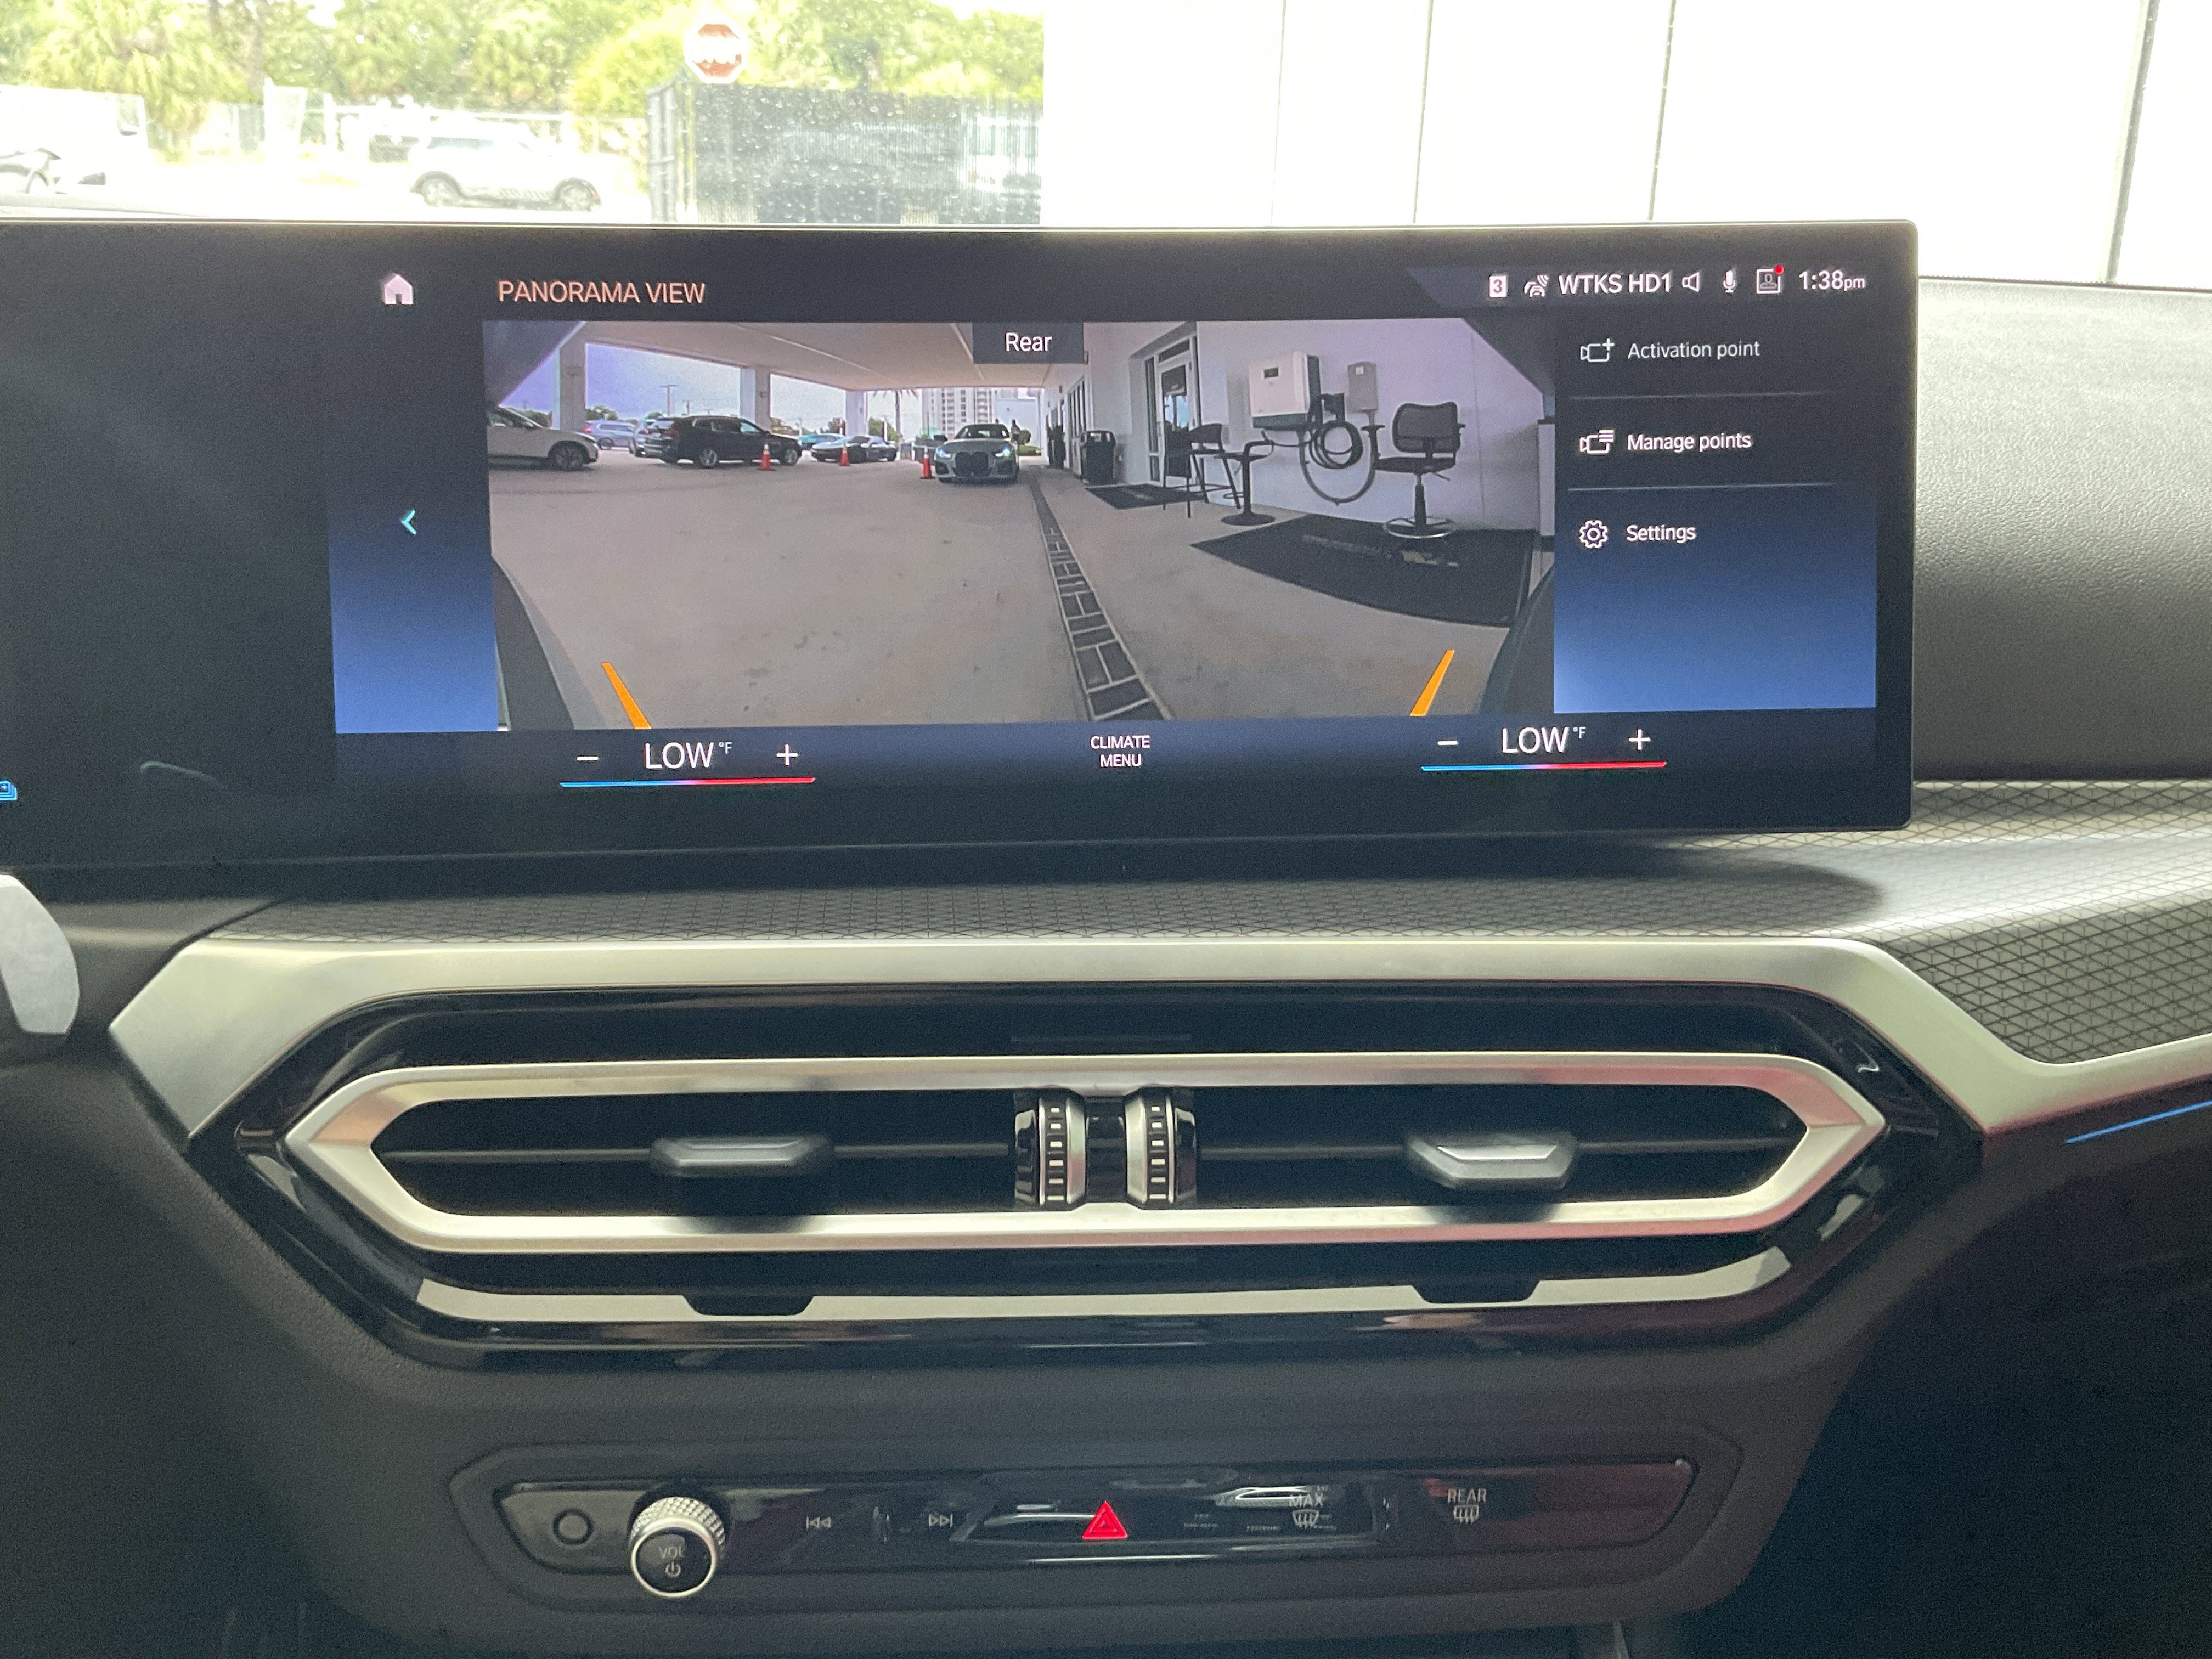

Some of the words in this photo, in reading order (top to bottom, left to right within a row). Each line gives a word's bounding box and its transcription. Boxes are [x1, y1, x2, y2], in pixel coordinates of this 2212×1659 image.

[498, 280, 641, 304] PANORAMA
[646, 281, 707, 304] VIEW
[1558, 274, 1623, 295] WTKS
[1628, 273, 1672, 294] HD1
[1798, 270, 1866, 292] 1:38pm
[1005, 332, 1052, 352] Rear
[1627, 341, 1712, 360] Activation
[1717, 341, 1760, 360] point
[1627, 433, 1695, 454] Manage
[1699, 432, 1752, 453] points
[1626, 524, 1697, 544] Settings
[1090, 734, 1151, 749] CLIMATE
[1501, 726, 1569, 754] LOW
[644, 742, 715, 770] LOW
[1099, 753, 1142, 768] MENU
[1288, 1492, 1324, 1508] MAX
[1447, 1487, 1487, 1504] REAR
[658, 1545, 686, 1559] VOL
